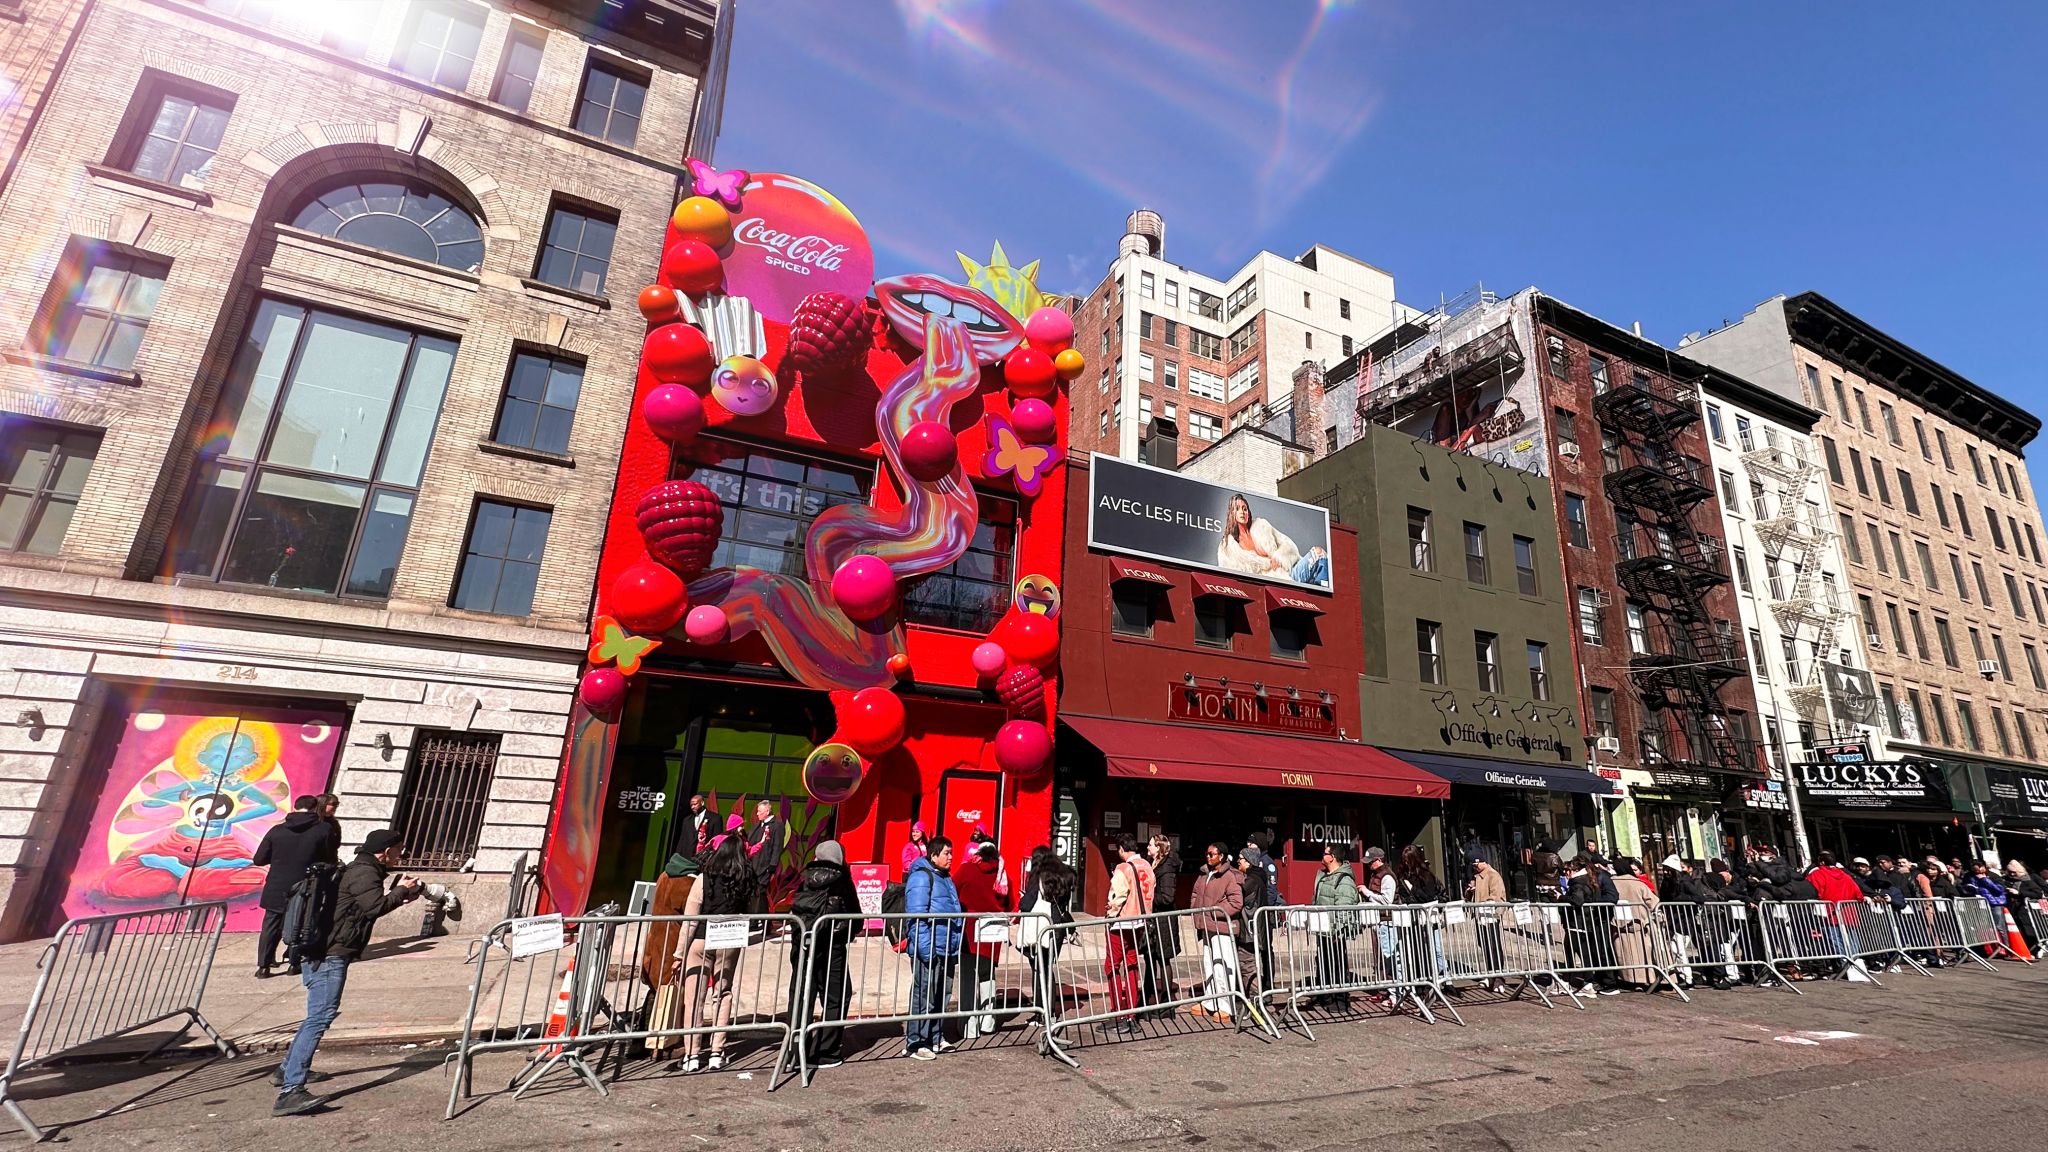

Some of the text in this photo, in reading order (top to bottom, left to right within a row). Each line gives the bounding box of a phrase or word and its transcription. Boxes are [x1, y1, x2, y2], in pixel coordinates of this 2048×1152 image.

[764, 255, 811, 276] SPICED
[700, 470, 820, 515] it's this
[1099, 495, 1222, 533] AVEC LES FILLES
[1123, 568, 1170, 583] MORINI
[1205, 583, 1249, 598] MORINI
[1280, 597, 1321, 611] MORINI
[216, 665, 258, 680] 214
[1280, 702, 1322, 719] OSERIA
[1449, 722, 1503, 746] Officine
[1281, 772, 1314, 787] MORINI
[1485, 771, 1547, 788] Officine Générale
[1800, 764, 1921, 783] LUCKYS
[619, 790, 666, 802] SPICED
[1751, 789, 1777, 802] SMOKE
[2021, 777, 2048, 798] LUC
[617, 800, 665, 811] SHOP
[1301, 823, 1351, 844] MORINI
